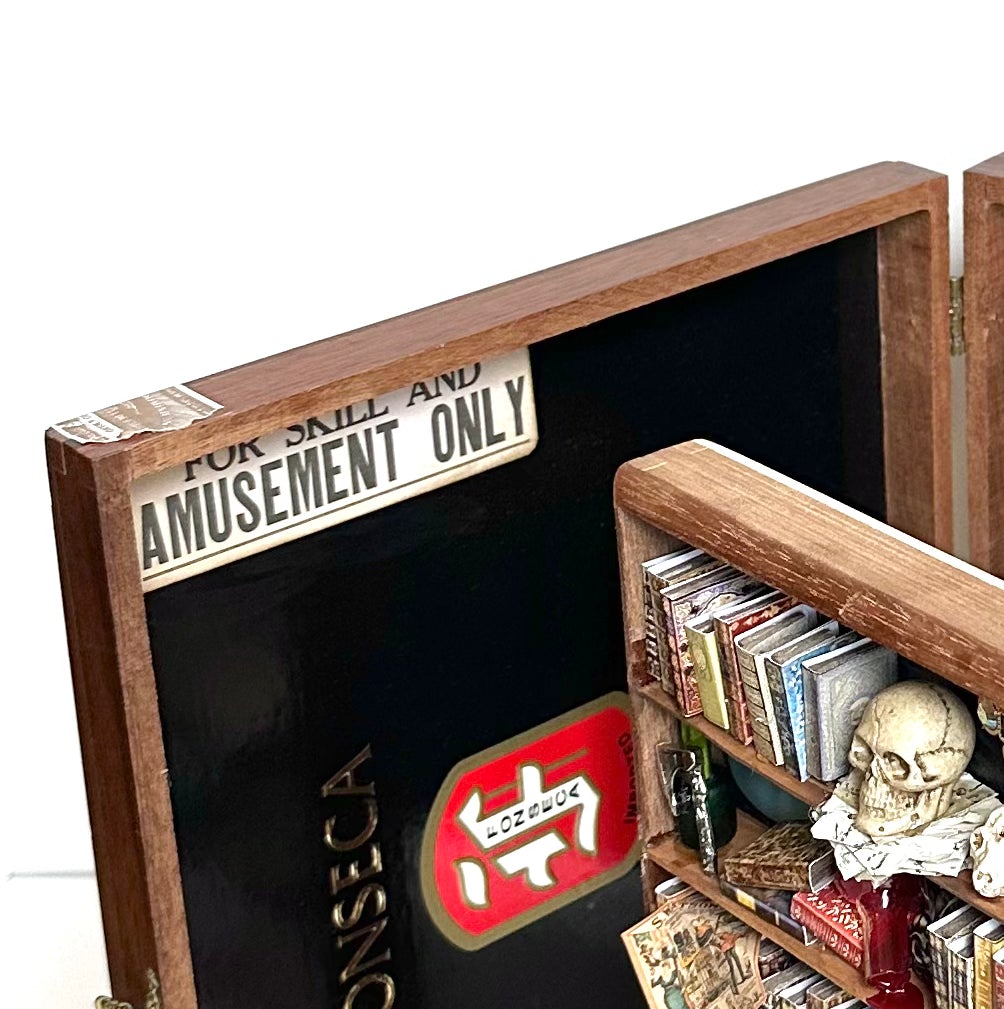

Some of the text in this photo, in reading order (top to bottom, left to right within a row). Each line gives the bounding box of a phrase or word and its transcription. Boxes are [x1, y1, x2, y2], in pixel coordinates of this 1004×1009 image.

[286, 398, 389, 448] SKILL
[407, 362, 481, 407] AND
[141, 375, 525, 570] AMUSEMENT ONLY
[486, 780, 581, 840] FONSECA
